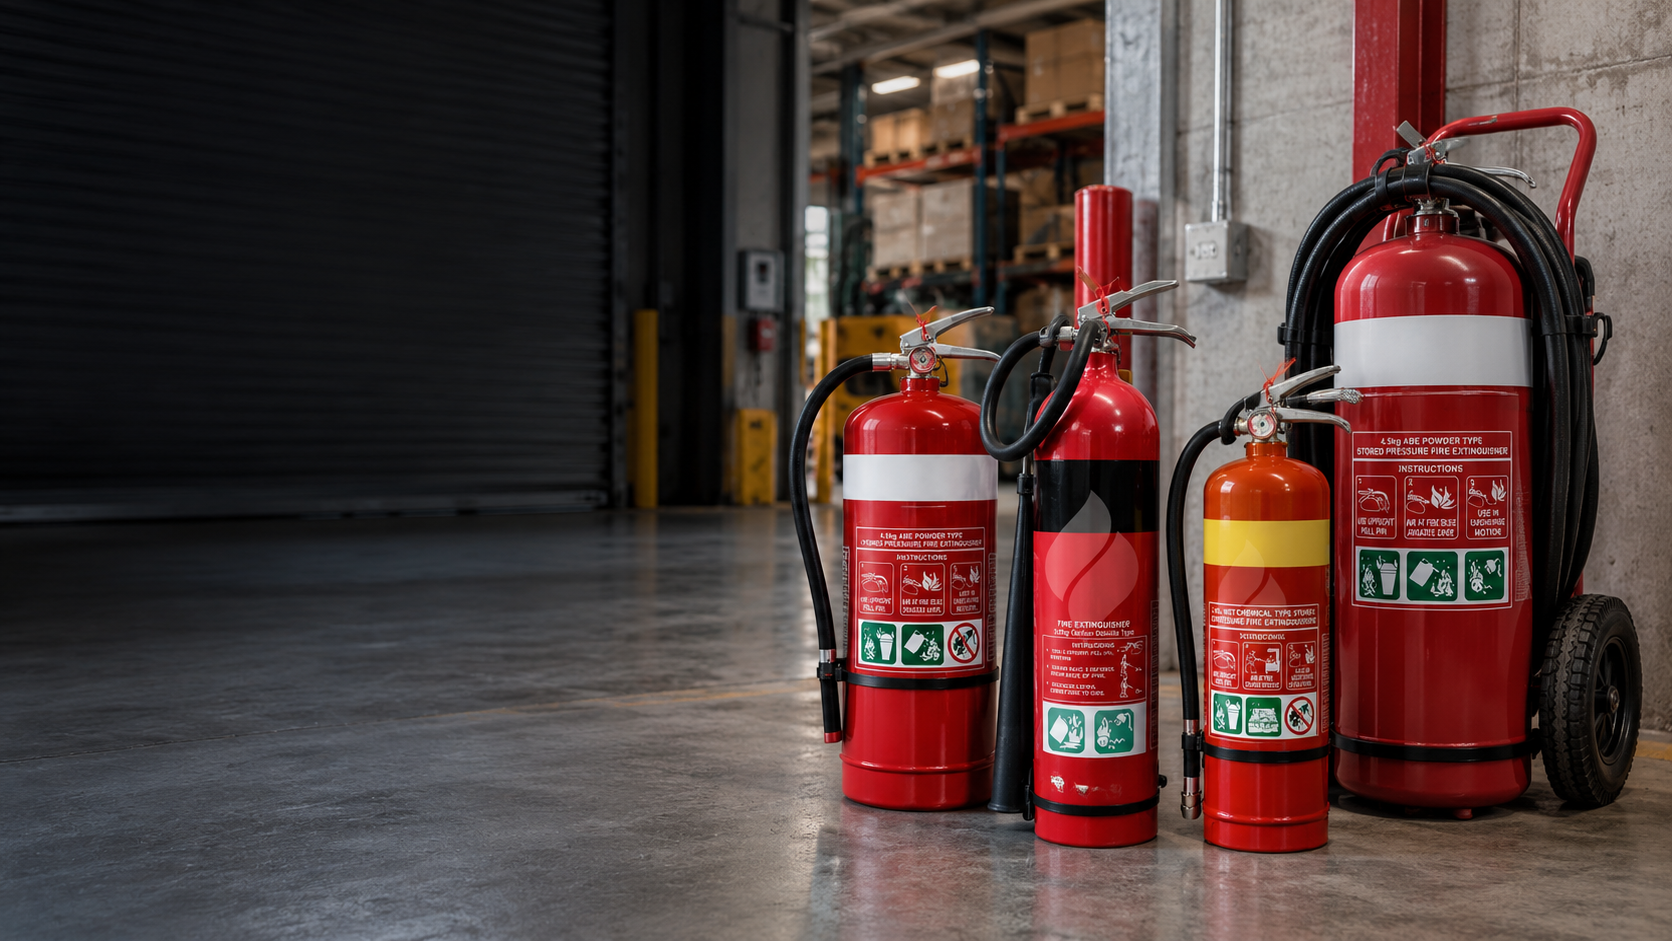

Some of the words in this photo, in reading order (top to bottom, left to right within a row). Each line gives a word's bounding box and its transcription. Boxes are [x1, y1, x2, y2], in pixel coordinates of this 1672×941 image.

[1422, 437, 1460, 445] POWDER
[1452, 447, 1508, 455] EXTINGUISHER
[1074, 620, 1131, 629] EXTINGUISHER
